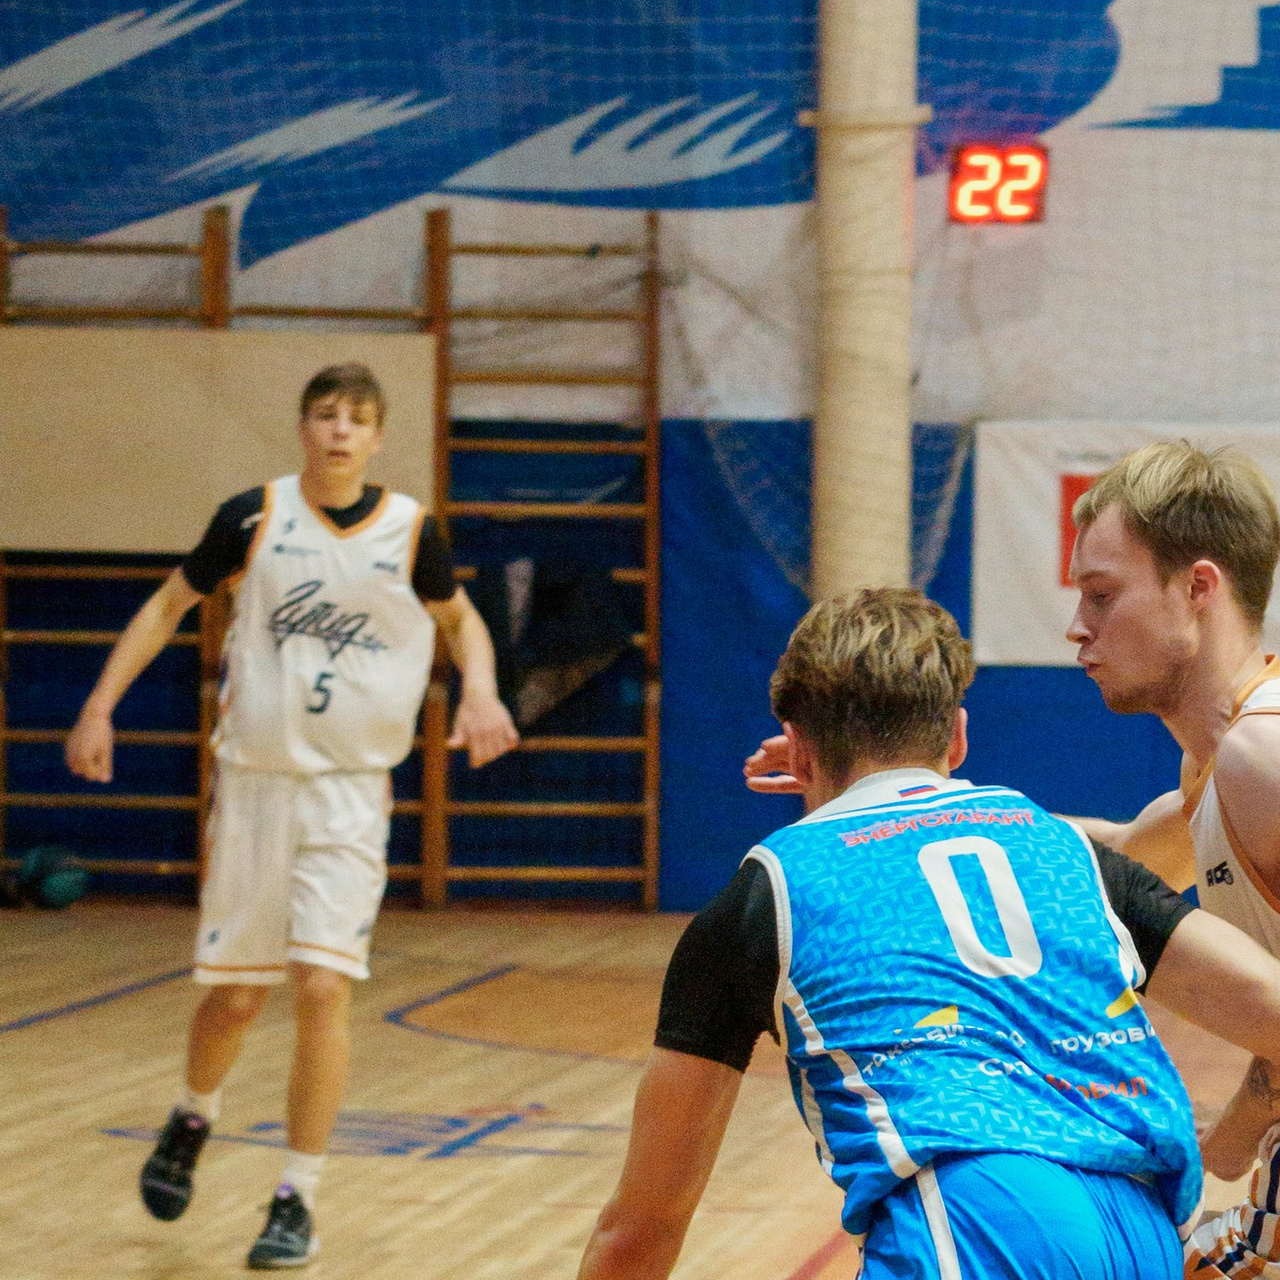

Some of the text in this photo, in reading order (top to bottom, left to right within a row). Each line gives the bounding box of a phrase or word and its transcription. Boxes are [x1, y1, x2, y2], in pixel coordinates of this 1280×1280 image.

[956, 153, 1042, 217] 22
[306, 671, 335, 714] 5
[840, 812, 1035, 847] ЭНЕРГОГАРАНТ
[917, 835, 1043, 979] 0
